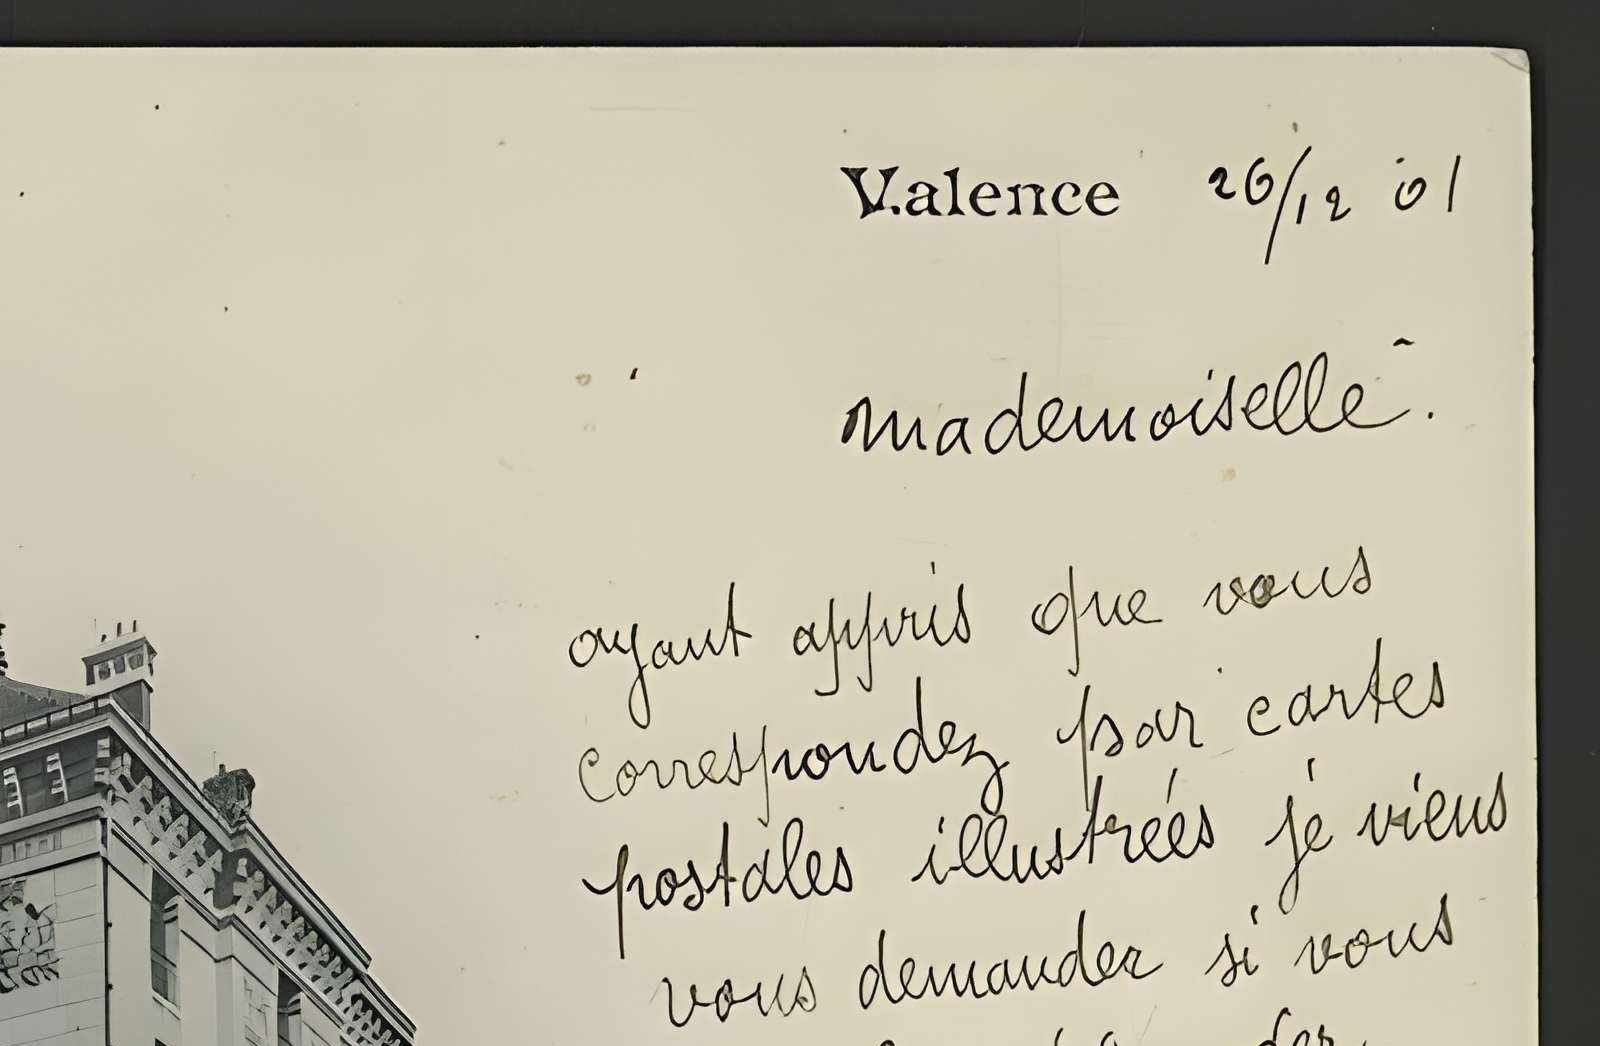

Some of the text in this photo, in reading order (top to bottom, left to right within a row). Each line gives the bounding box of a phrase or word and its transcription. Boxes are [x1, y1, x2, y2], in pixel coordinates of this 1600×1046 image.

[840, 164, 1121, 218] Valence
[1031, 565, 1164, 676] que
[1203, 545, 1373, 617] vous
[1057, 685, 1206, 812] par
[1245, 637, 1447, 735] cartes
[1264, 757, 1335, 915] je
[1357, 771, 1510, 838] viens
[662, 962, 818, 1027] vous
[1294, 893, 1456, 975] vous
